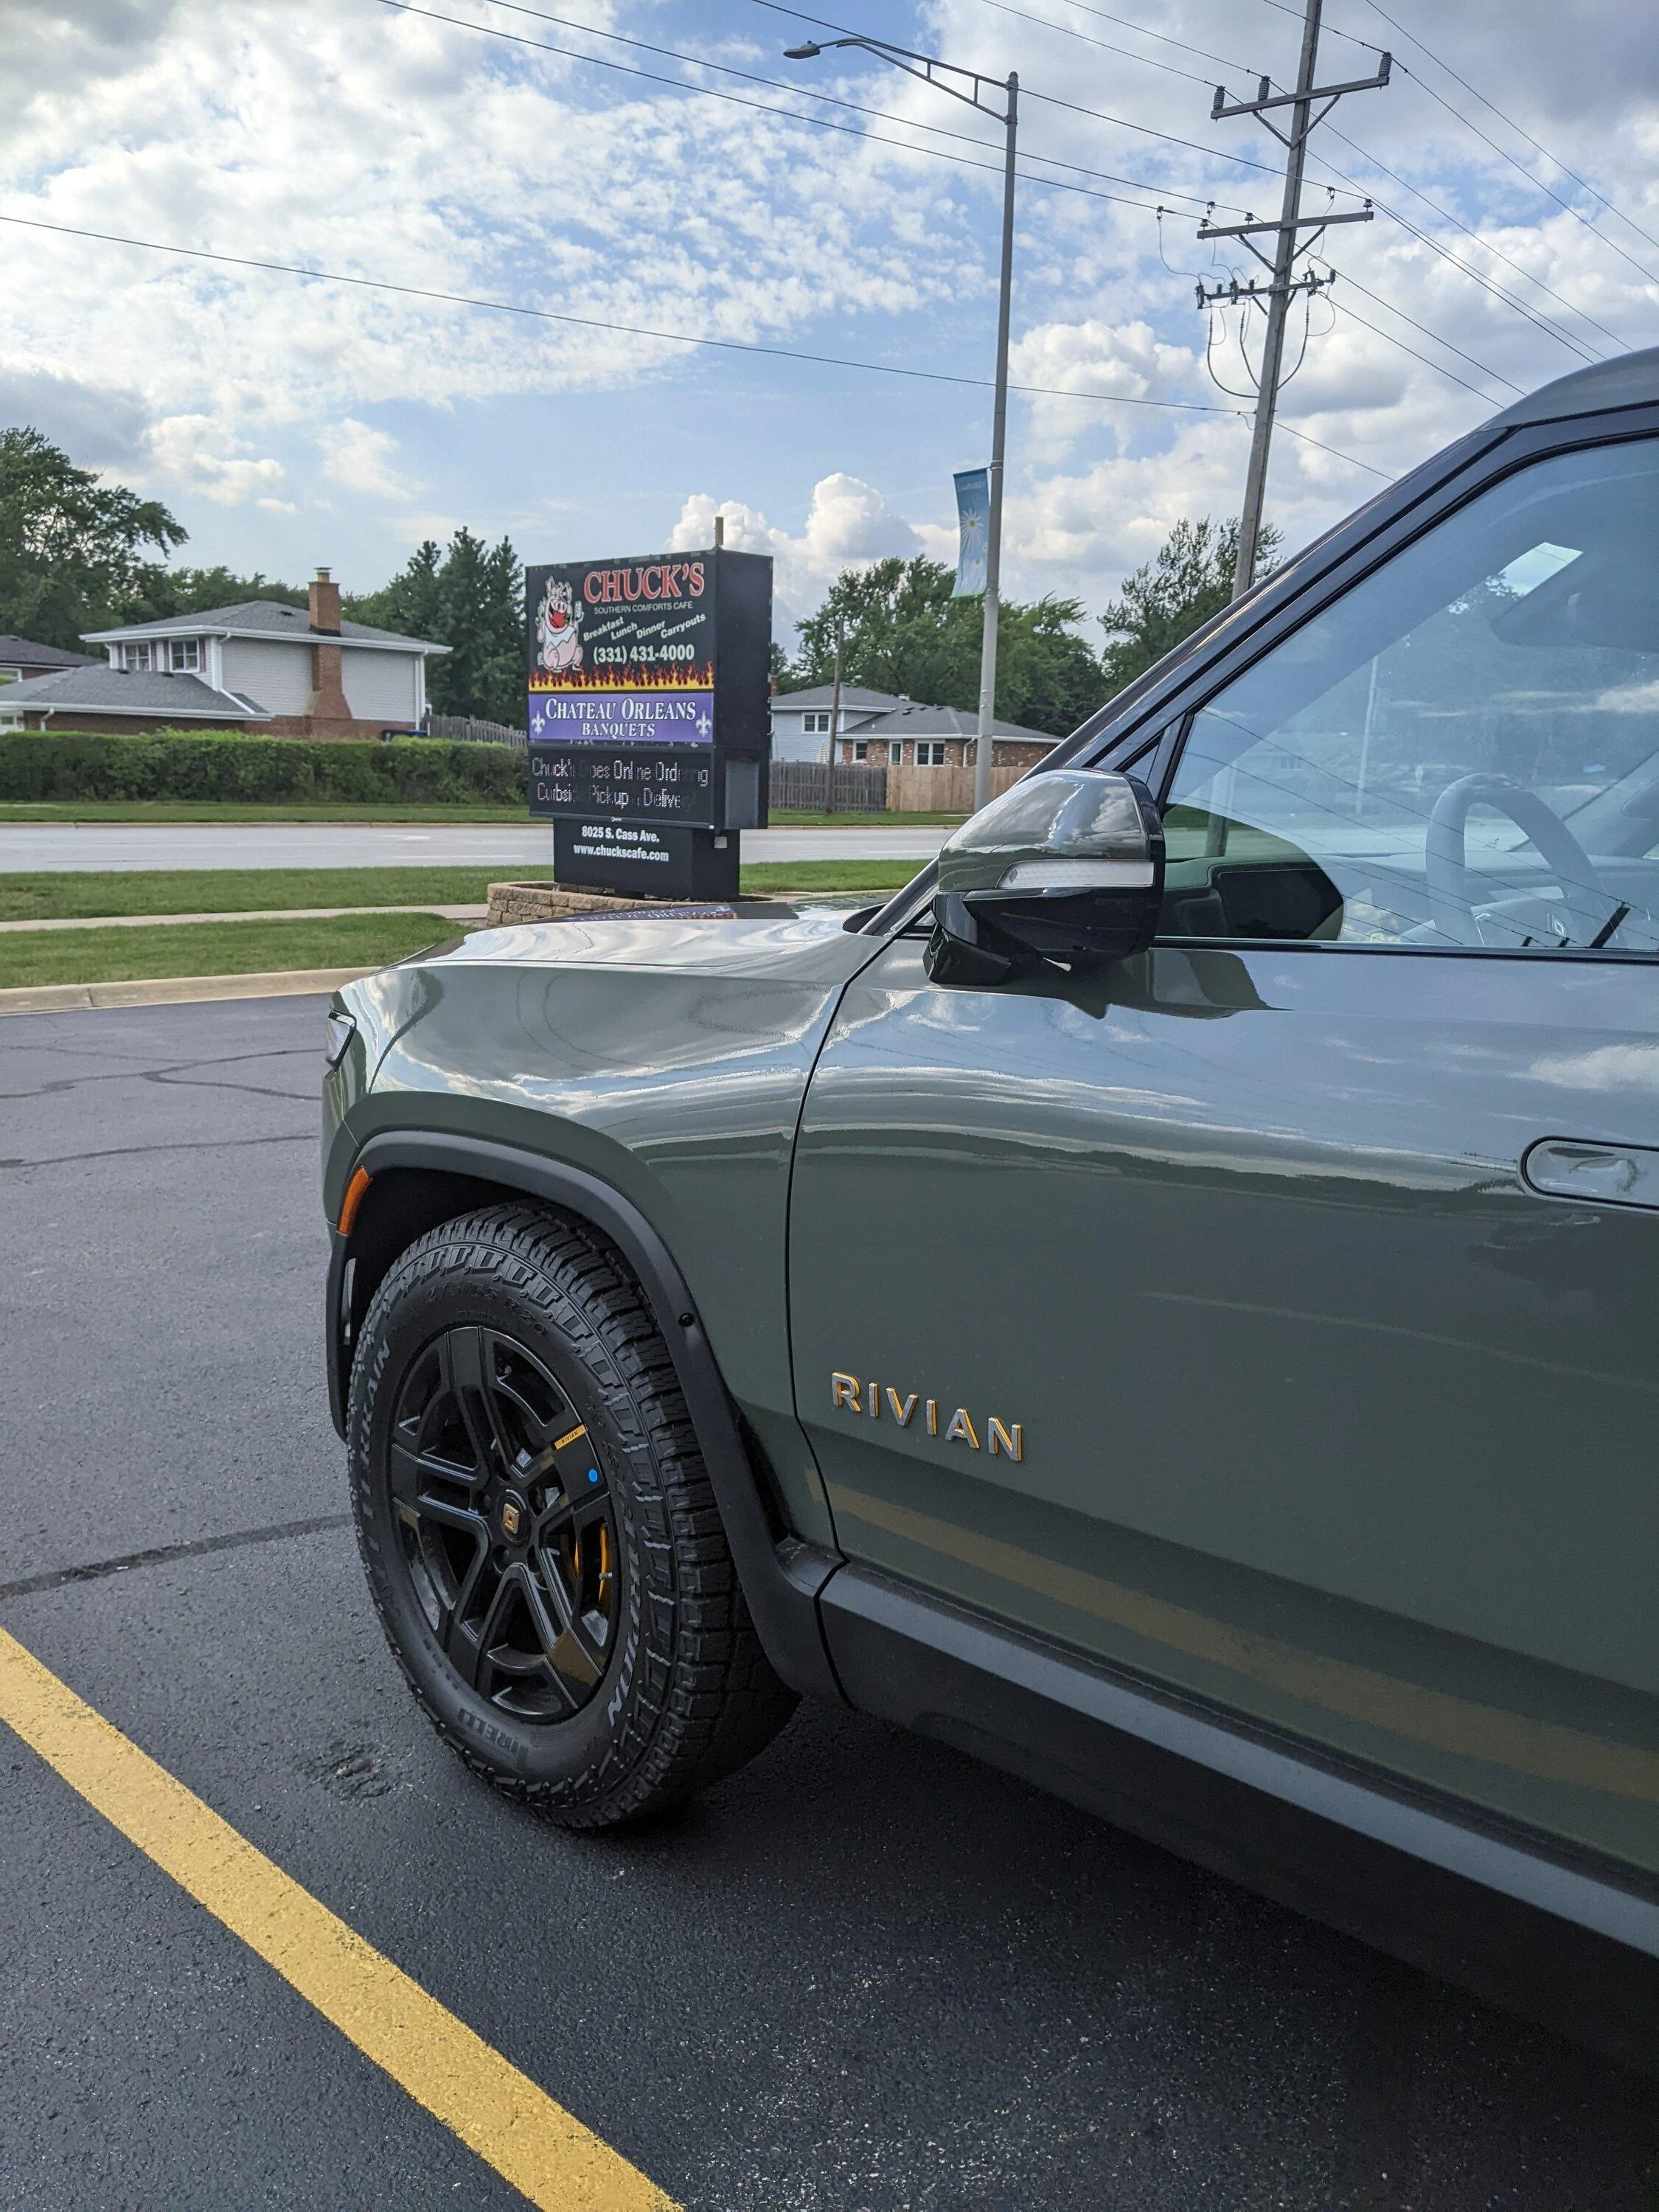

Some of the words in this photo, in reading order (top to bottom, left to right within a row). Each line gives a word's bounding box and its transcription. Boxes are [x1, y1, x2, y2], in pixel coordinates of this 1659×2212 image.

[584, 562, 705, 603] CHUCK'S
[594, 605, 631, 615] SOUTHERN
[633, 602, 672, 613] COMFORTS
[673, 601, 693, 610] CAFE
[583, 616, 625, 641] Breakfast
[611, 622, 638, 641] Lunch
[636, 620, 666, 639] Dinner
[661, 613, 706, 639] Carryouts
[593, 644, 627, 665] (331)
[629, 644, 695, 663] 431-4000
[545, 698, 616, 720] CHATEAU
[622, 698, 696, 720] ORLEANS
[582, 723, 655, 740] BANQUETS
[613, 760, 652, 780] Onlne
[581, 825, 604, 838] 8025
[605, 827, 614, 839] S.
[616, 828, 638, 841] Cass
[639, 830, 660, 843] Ave.
[573, 844, 669, 862] www.chuckscafe.com
[832, 1371, 1024, 1462] RIVIAN
[560, 1430, 579, 1444] RIVIAN
